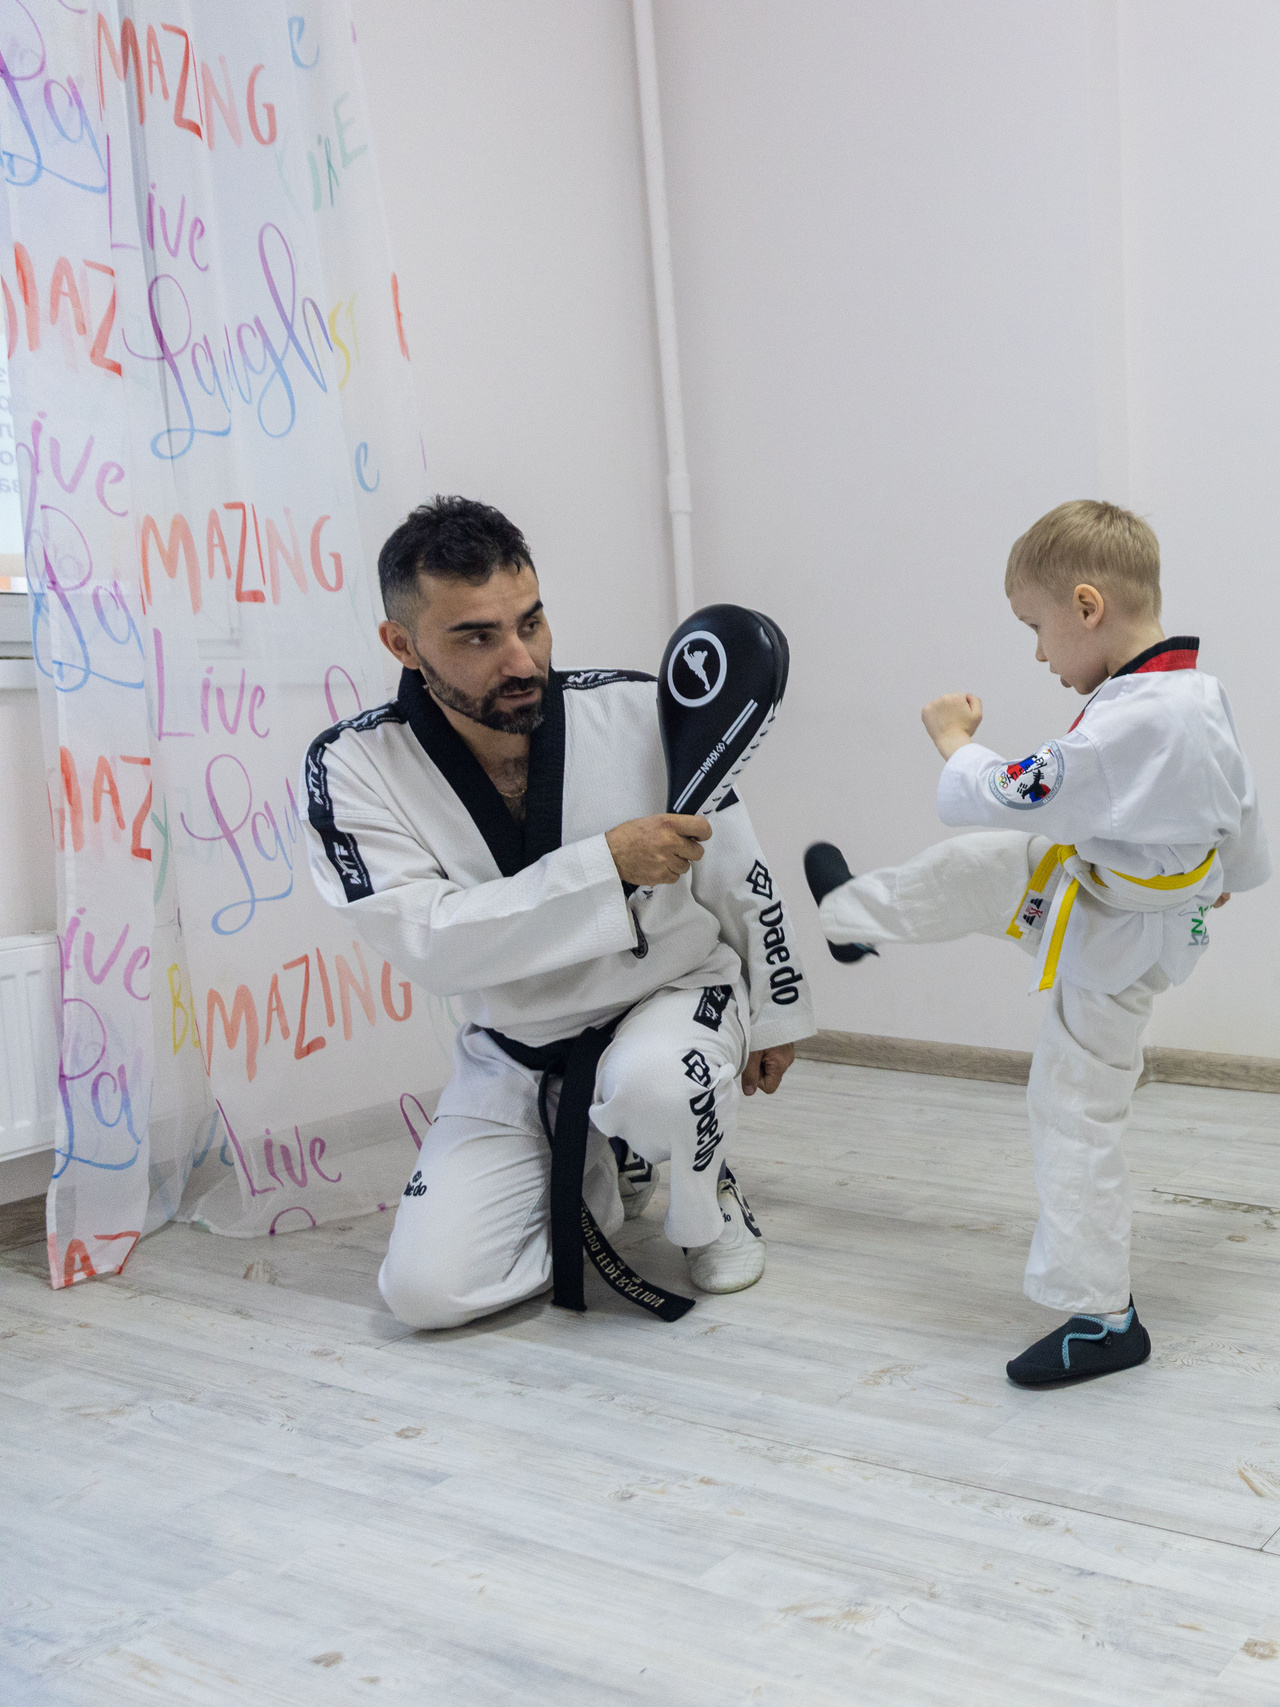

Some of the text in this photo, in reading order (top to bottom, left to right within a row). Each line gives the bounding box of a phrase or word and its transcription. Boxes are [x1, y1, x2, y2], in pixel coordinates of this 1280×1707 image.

[107, 134, 209, 272] Live
[153, 627, 269, 741] Live
[700, 749, 720, 774] KHAN
[758, 900, 803, 1005] Daedo
[195, 940, 413, 1082] MAZING
[214, 1098, 343, 1197] Live
[689, 1087, 724, 1172] Daedo
[596, 1251, 665, 1308] FEDERATION
